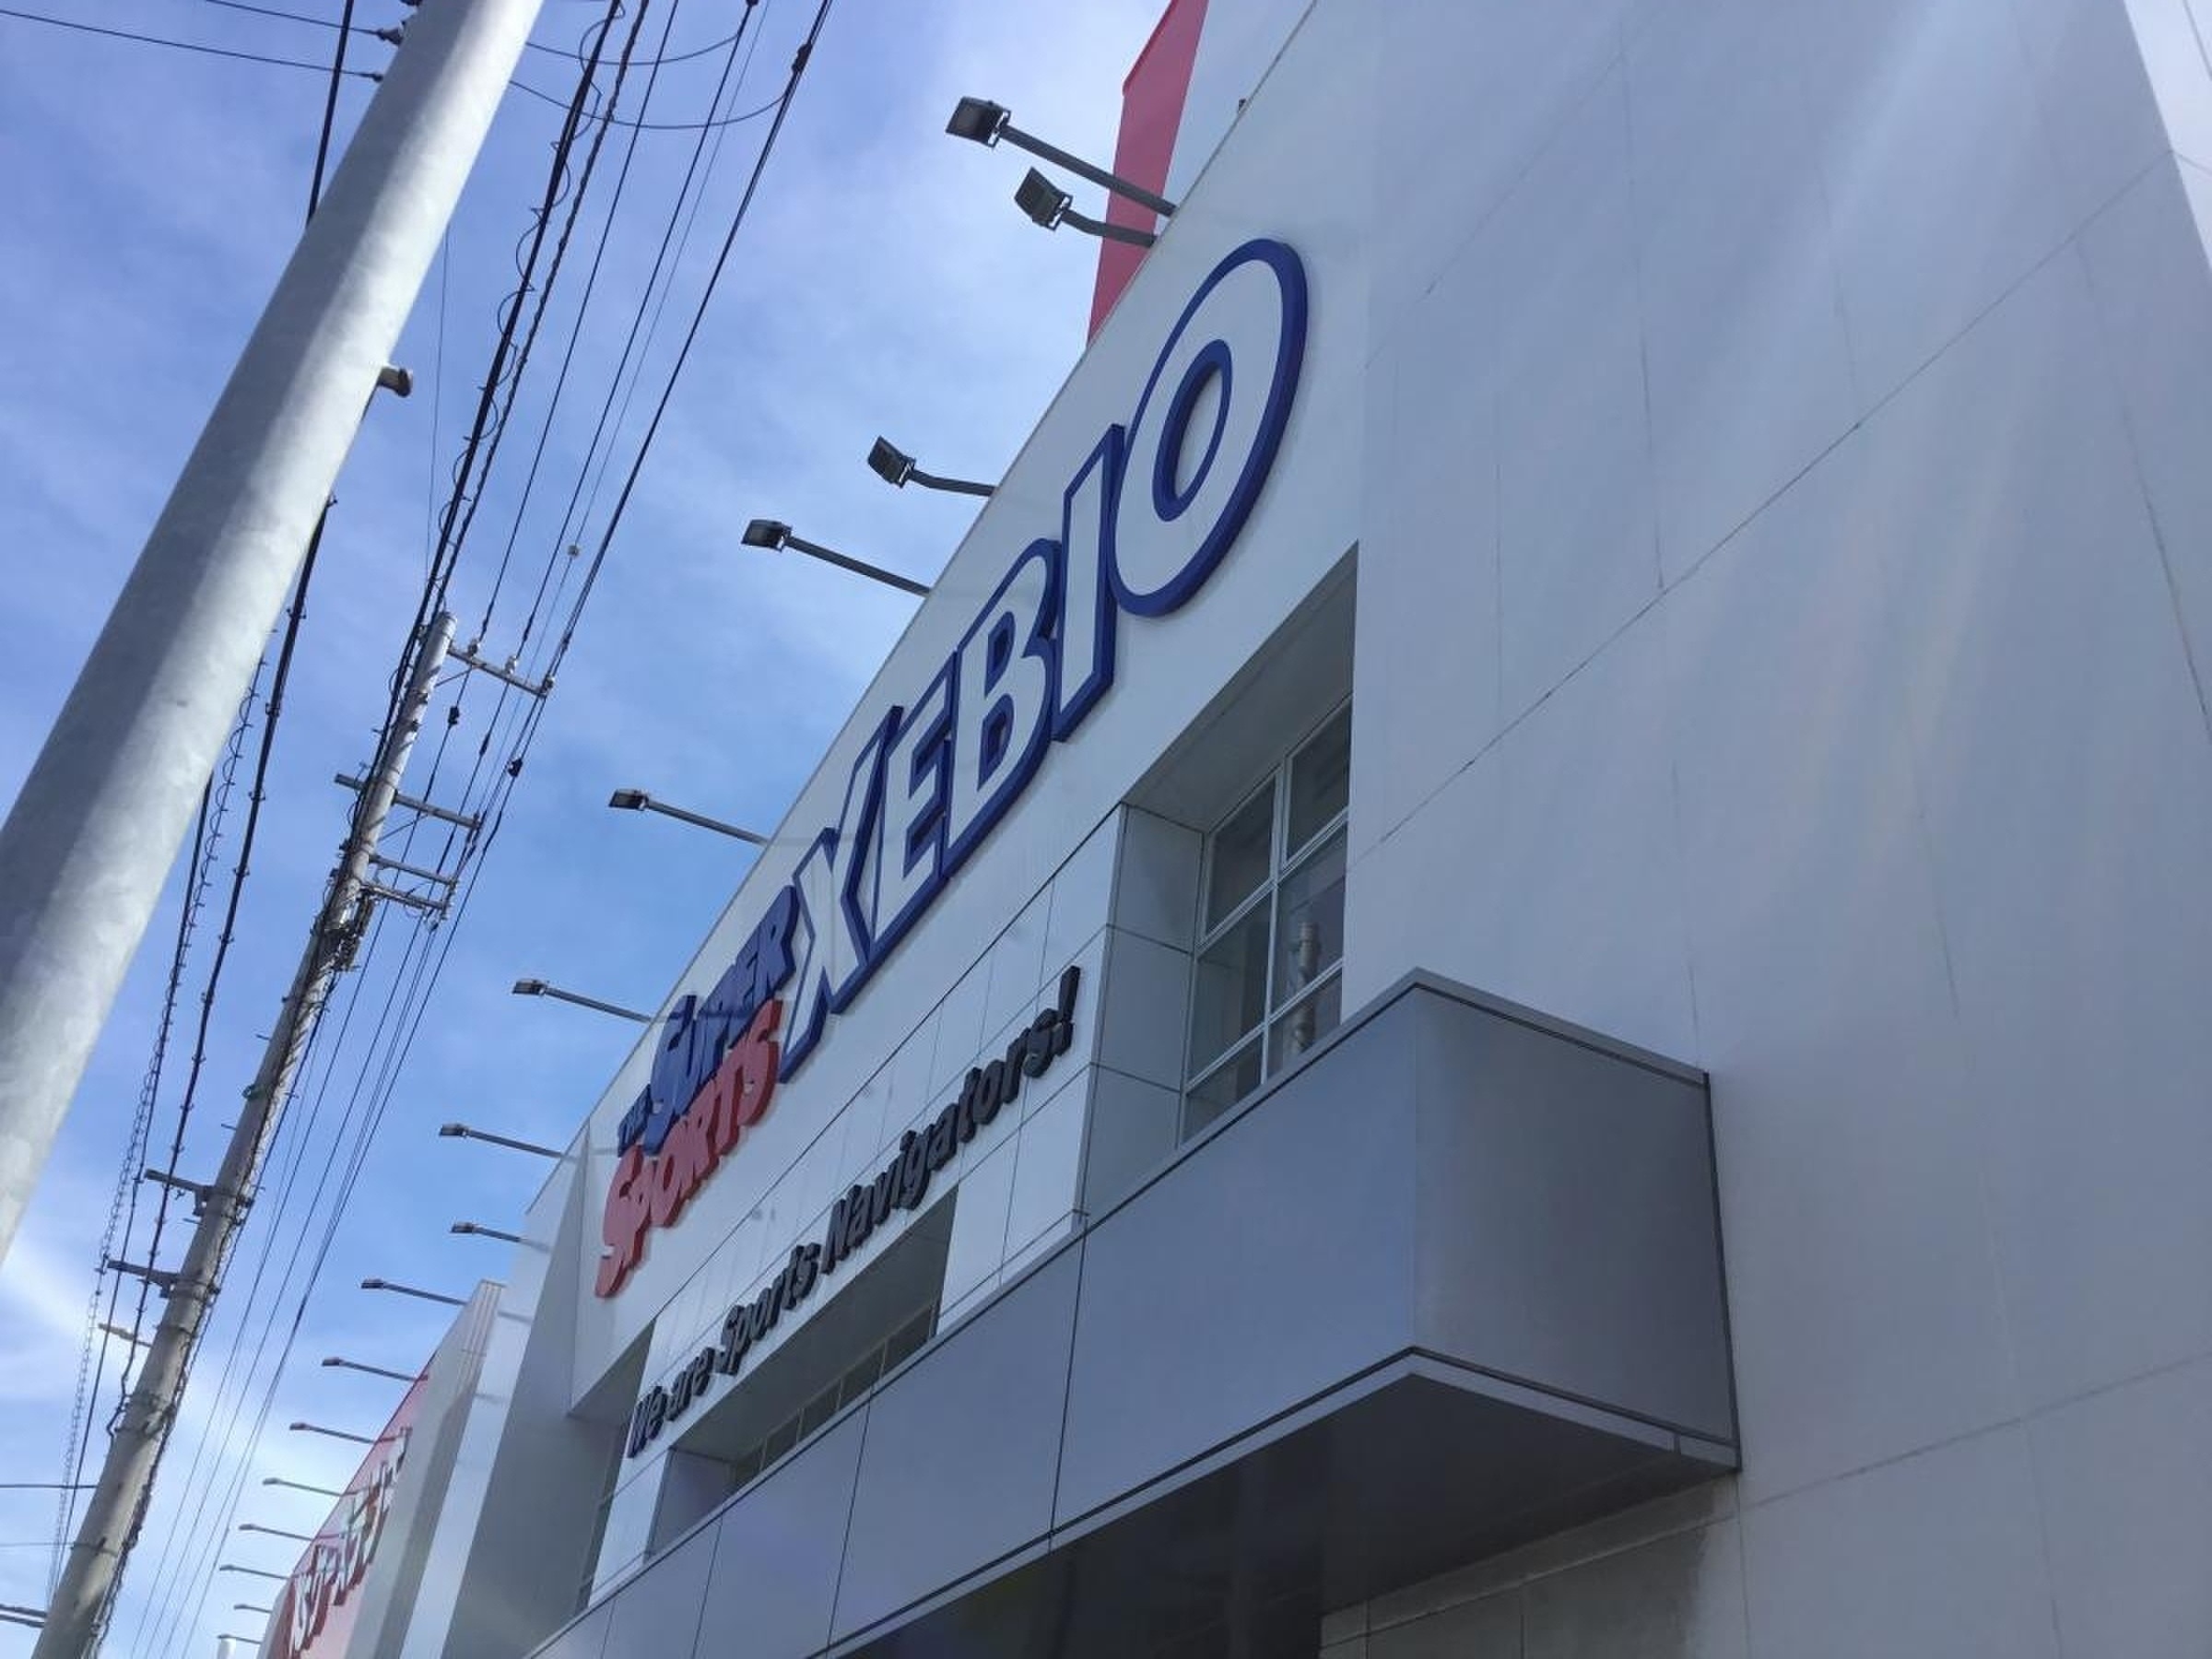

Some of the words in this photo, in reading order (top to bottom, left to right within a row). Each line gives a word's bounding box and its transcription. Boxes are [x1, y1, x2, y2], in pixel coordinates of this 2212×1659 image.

[780, 238, 1309, 1084] XEBIO
[595, 999, 783, 1298] SPORTS
[628, 1384, 665, 1458] We
[665, 1345, 715, 1421] are
[715, 1242, 821, 1376] Sports
[822, 965, 1080, 1275] Navigators!
[642, 885, 799, 1156] SUPER
